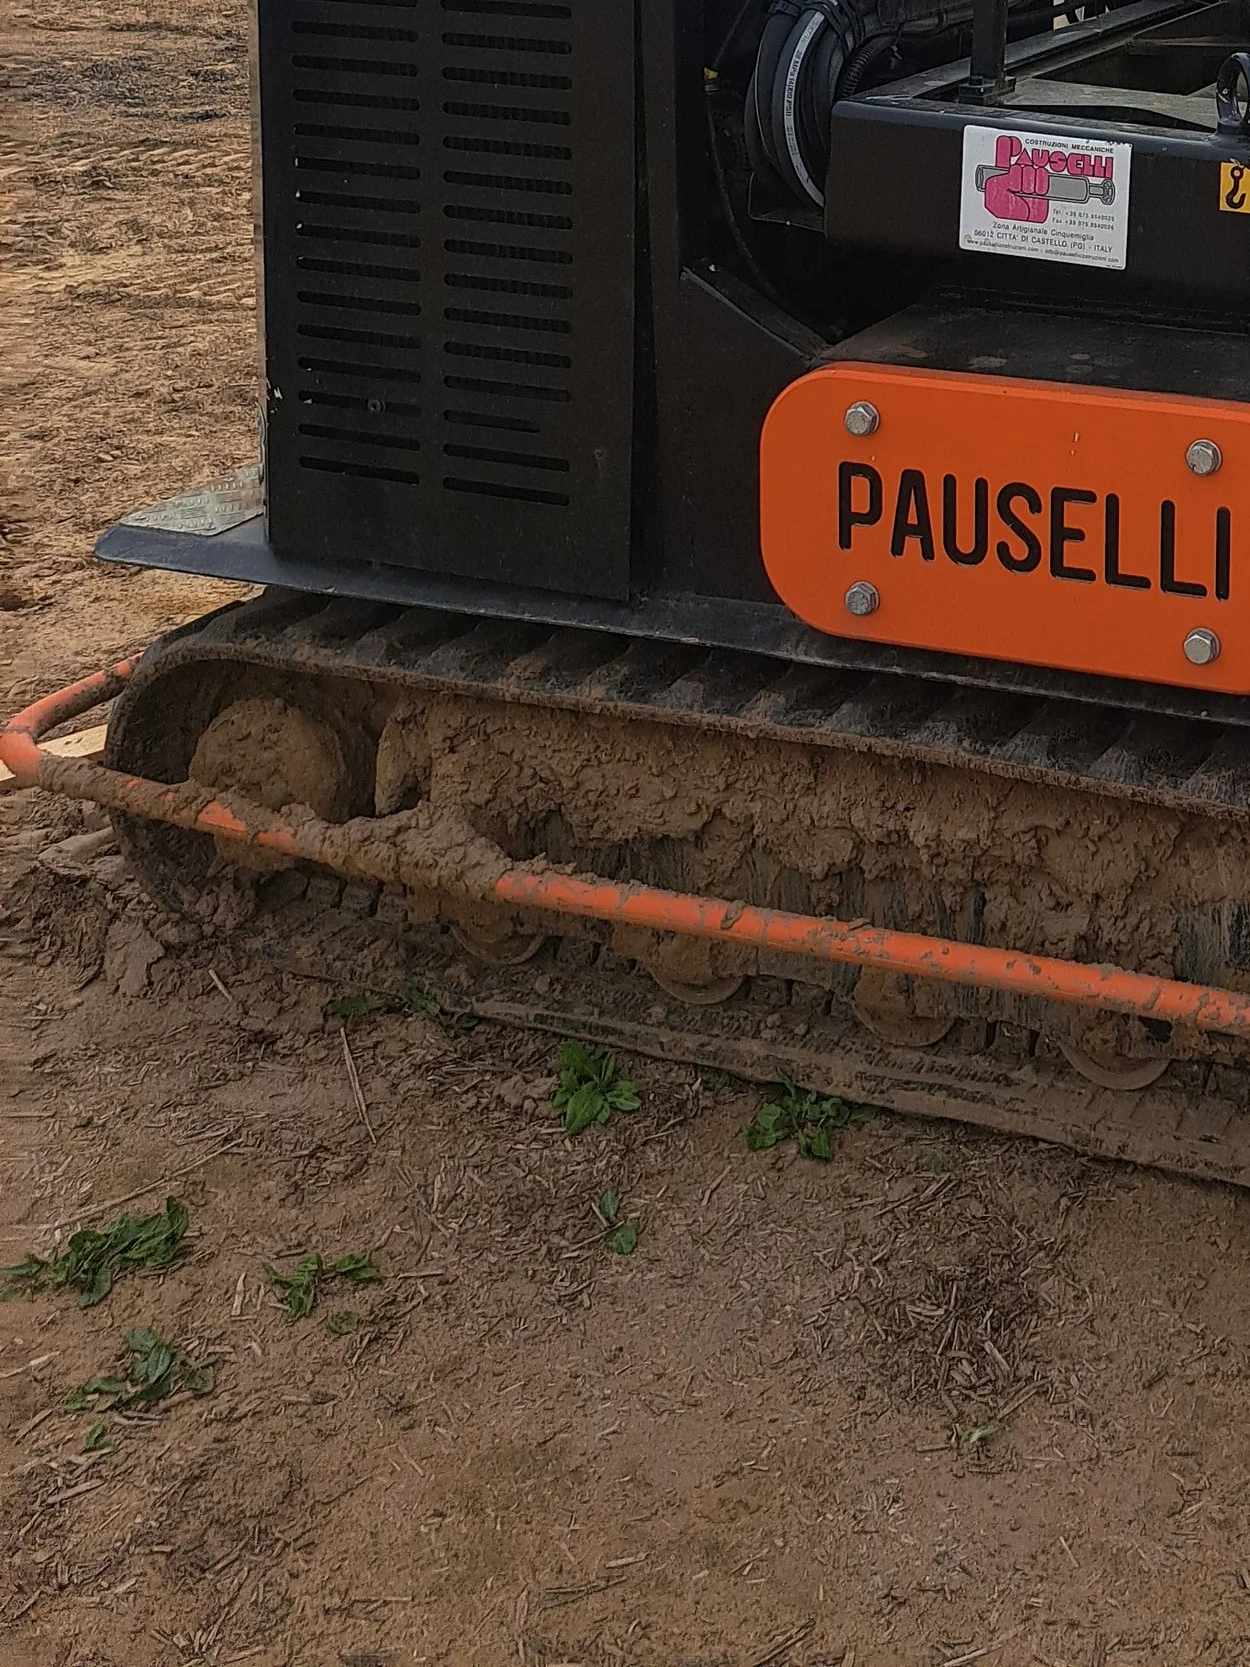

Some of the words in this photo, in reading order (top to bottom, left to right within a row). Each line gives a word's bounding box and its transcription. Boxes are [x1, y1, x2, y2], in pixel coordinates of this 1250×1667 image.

[1025, 138, 1069, 149] COSTRUZIONI
[1071, 144, 1114, 154] MECCANICHE
[992, 221, 1010, 230] Zona
[1012, 224, 1048, 235] Artigianale
[1050, 228, 1095, 242] Cinquemiglia
[1031, 236, 1067, 248] CASTELLO
[1093, 244, 1113, 253] ITALY
[837, 461, 1231, 601] PAUSELLI
